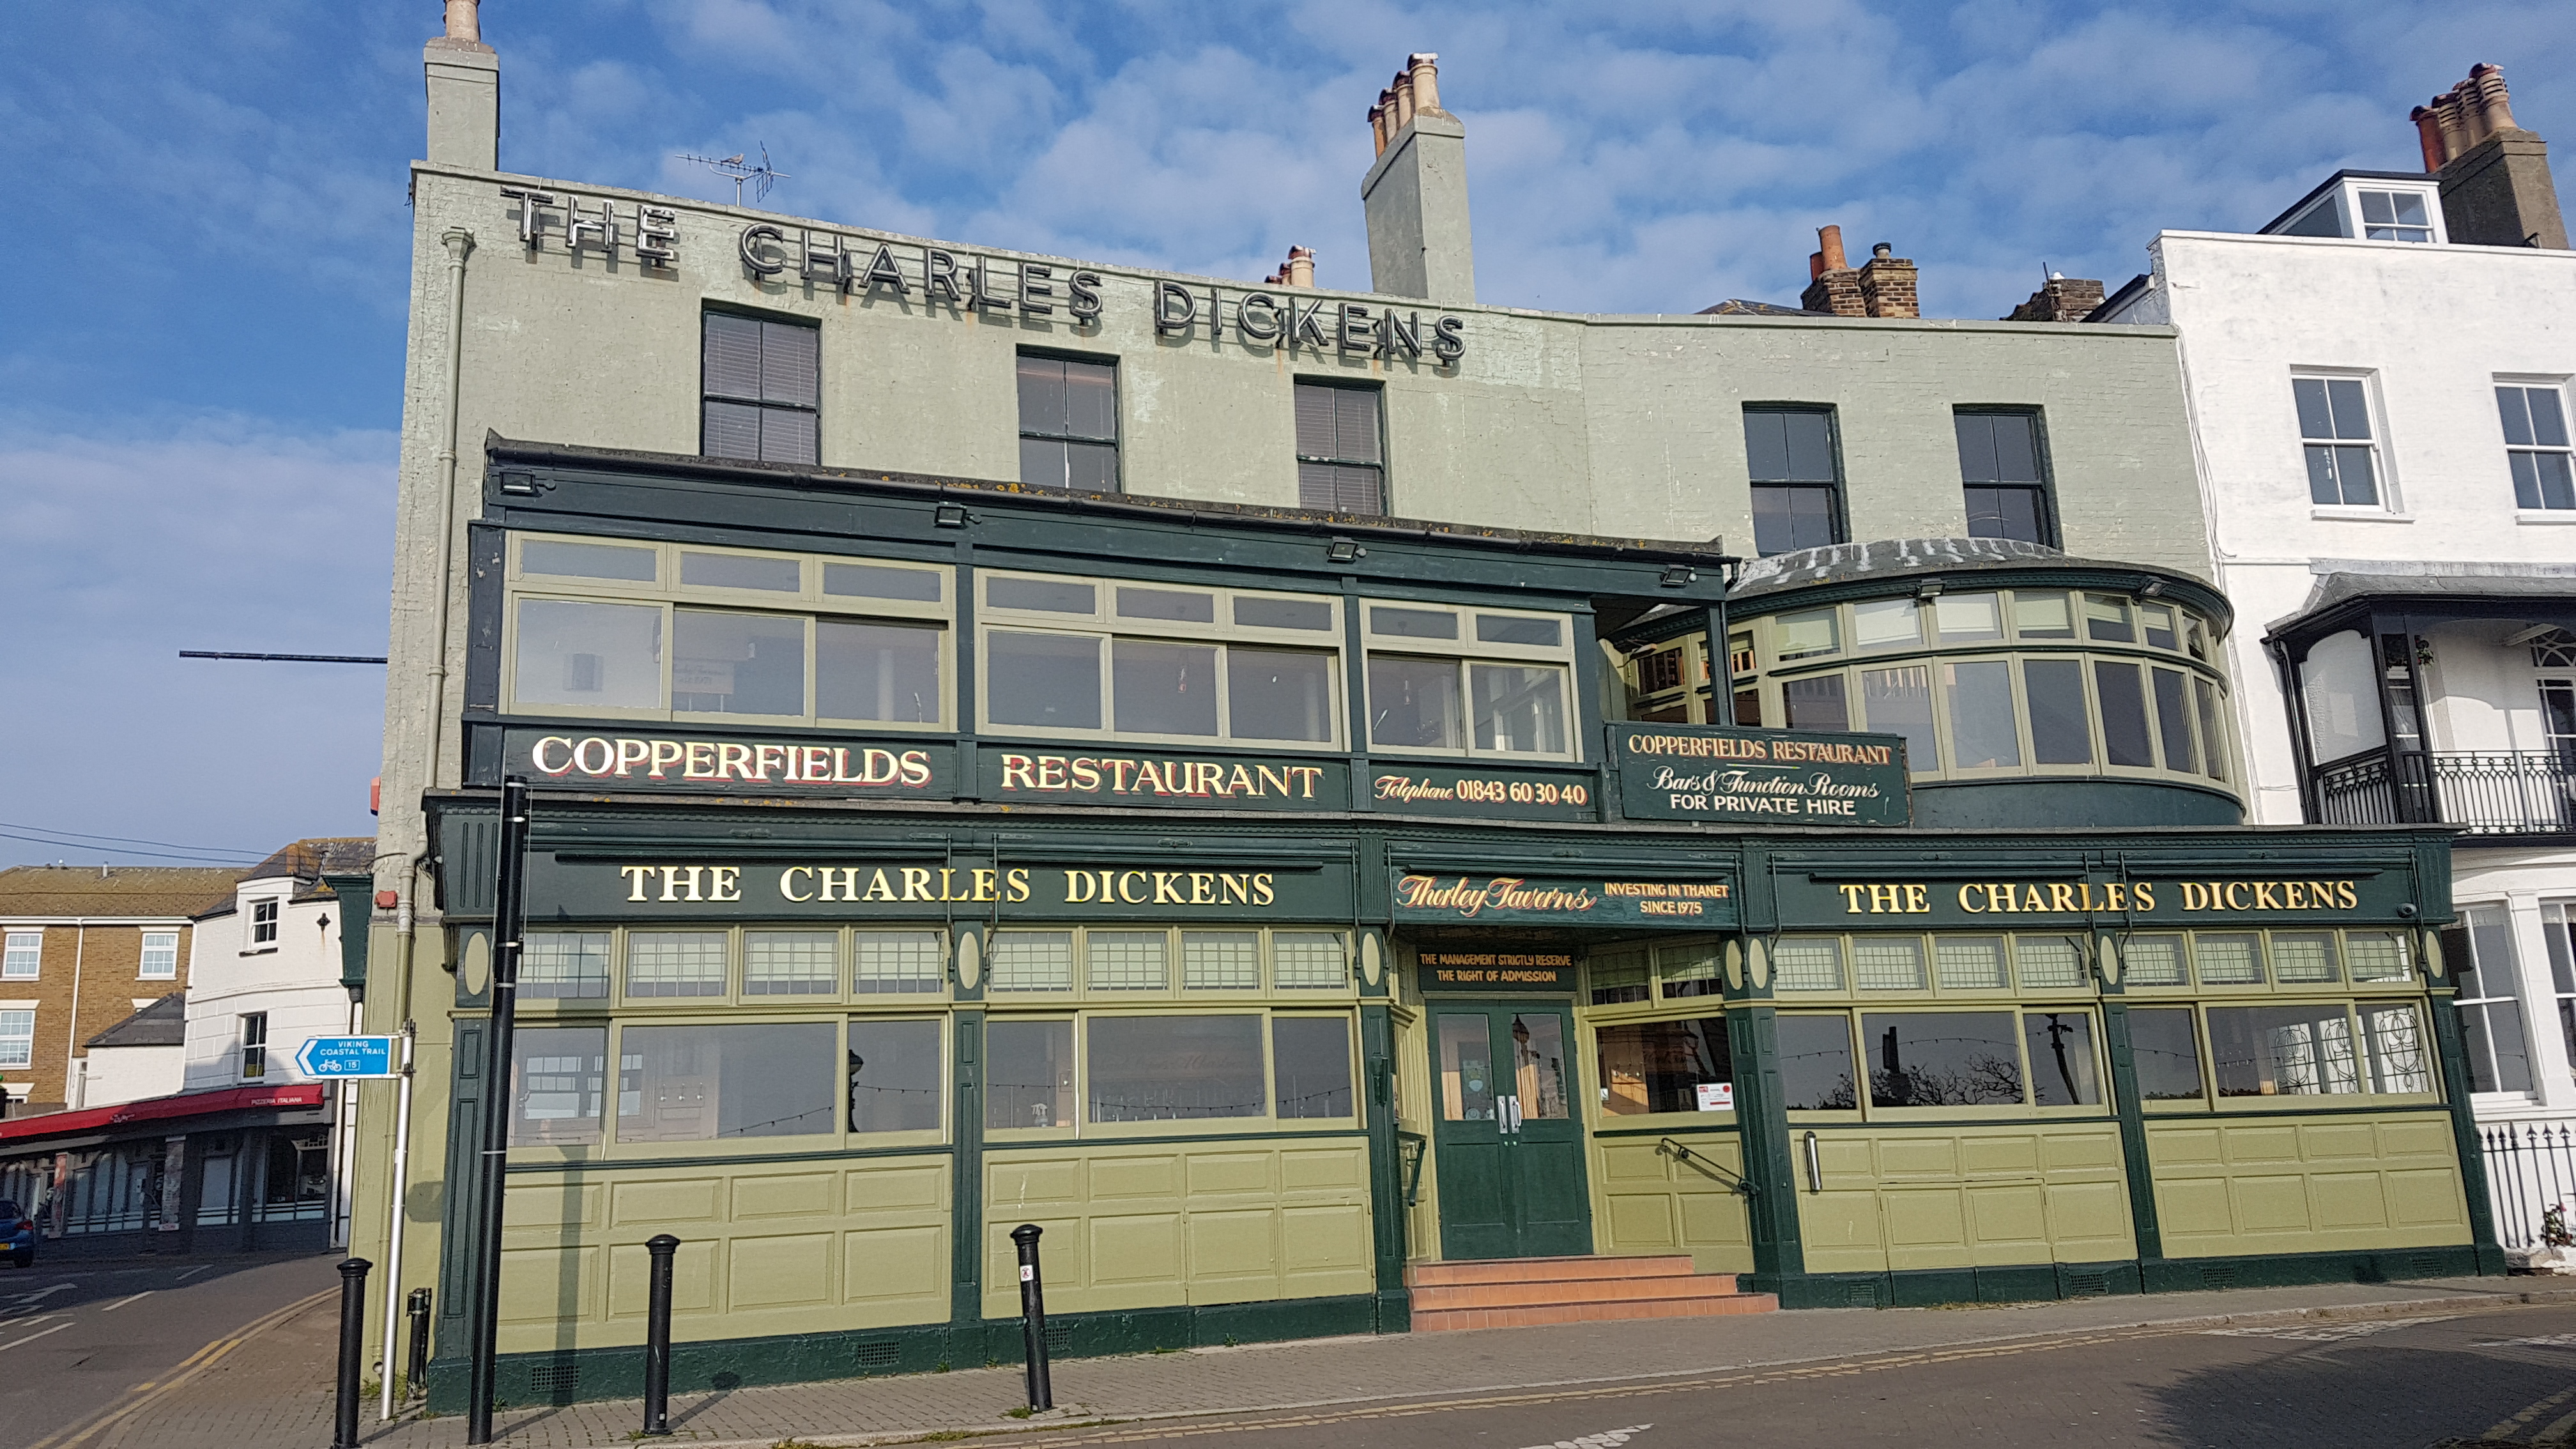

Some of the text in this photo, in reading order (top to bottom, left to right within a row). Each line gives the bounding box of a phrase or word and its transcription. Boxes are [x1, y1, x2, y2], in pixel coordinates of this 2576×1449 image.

[500, 186, 1466, 362] THE CHARLES DICKENS
[1629, 734, 1893, 765] COPPERFIELDS RESTAURANT
[532, 736, 1325, 800] COPPERFIELDS RESTAURANT
[1374, 775, 1588, 806] Telephone 01843 60 30 40
[1701, 770, 1719, 796] &
[1720, 770, 1805, 795] Function
[1803, 772, 1882, 799] Rooms
[1671, 793, 1856, 816] FOR PRIVATE HIRE
[621, 865, 1275, 906] THE CHARLES DICKENS
[1397, 875, 1597, 917] Thorley Taverns
[1604, 882, 1729, 898] INVESTING IN THANET
[1840, 880, 2359, 914] THE CHARLES DICKENS
[1640, 901, 1703, 915] SINCE 1975
[1420, 954, 1571, 966] THE MANAGEMENT STRICTLY RESERVE
[1438, 970, 1556, 982] THE RIGHT OF ADMISSION
